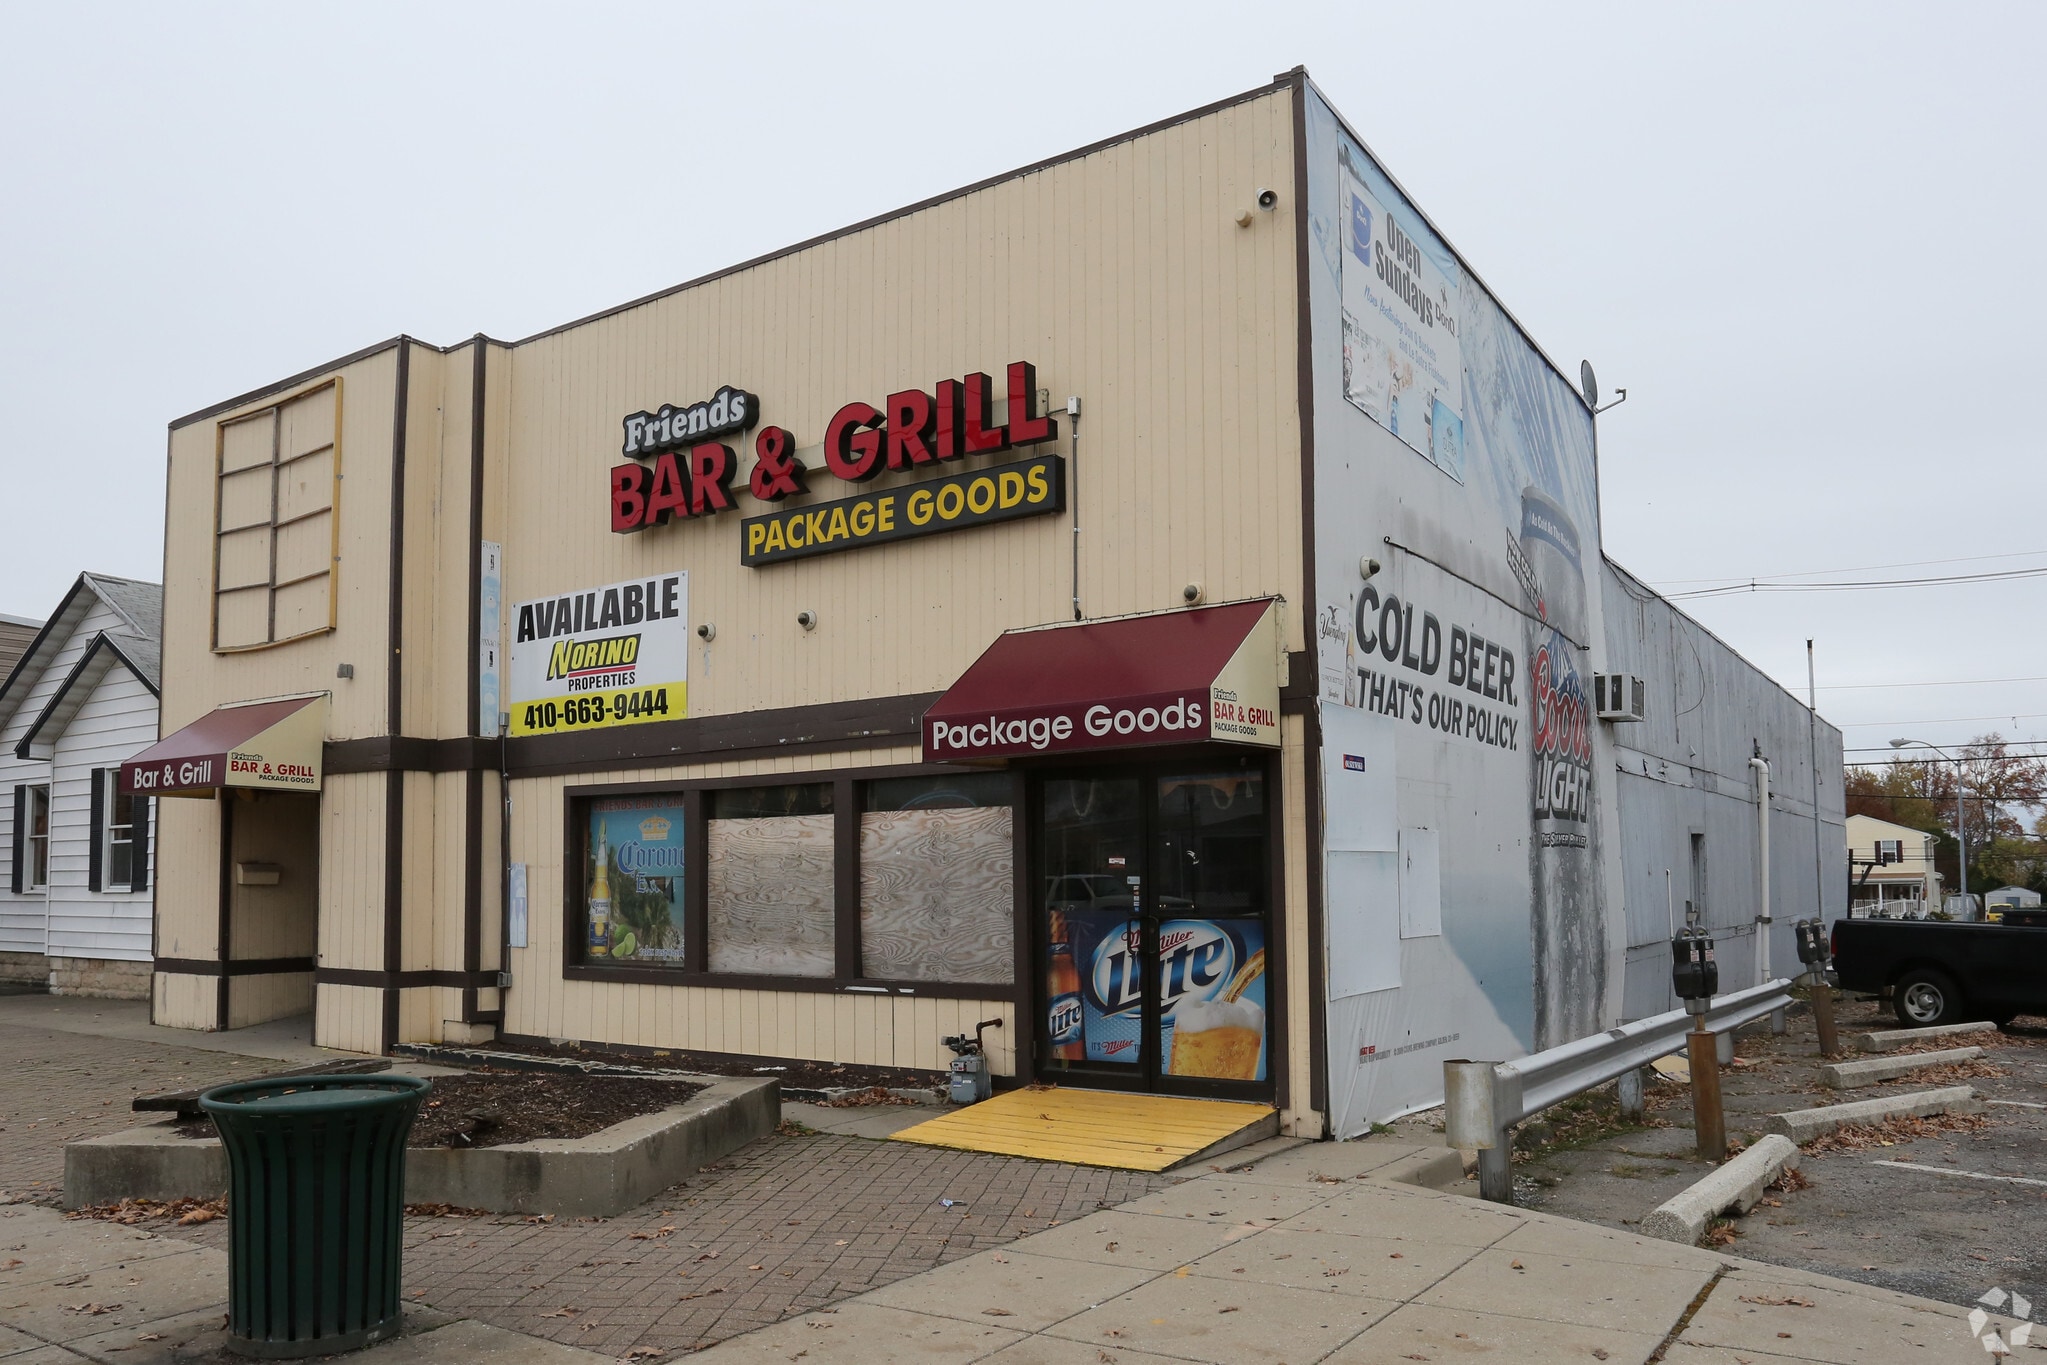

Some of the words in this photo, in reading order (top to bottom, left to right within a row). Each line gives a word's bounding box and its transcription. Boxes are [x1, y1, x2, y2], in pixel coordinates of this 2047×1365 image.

[1387, 212, 1421, 279] Open
[1375, 240, 1433, 328] Sundays
[1435, 302, 1456, 337] DonQ
[625, 389, 746, 453] Friends
[611, 442, 738, 534] BAR
[749, 425, 809, 502] &
[824, 360, 1058, 483] GRILL
[748, 496, 896, 557] PACKAGE
[907, 464, 1049, 527] GOODS
[517, 578, 680, 644] AVAILABLE
[1319, 612, 1347, 647] Yuengling
[1356, 583, 1441, 676] COLD
[1448, 623, 1518, 707] BEER.
[547, 635, 640, 680] NORINO
[567, 671, 635, 692] PROPERTIES
[1214, 687, 1238, 702] Friends
[524, 689, 669, 730] 410-663-9444
[1214, 701, 1235, 721] BAR
[1238, 705, 1246, 723] &
[1248, 707, 1275, 727] GRILL
[1357, 666, 1424, 726] THAT'S
[1428, 691, 1462, 734] OUR
[1466, 707, 1518, 751] POLICY.
[1530, 644, 1592, 766] Coors
[933, 715, 1073, 750] Package
[1084, 697, 1203, 737] Goods
[1214, 722, 1237, 733] PACKAGE
[1238, 725, 1257, 736] GOODS
[231, 752, 263, 761] Friends
[231, 760, 258, 773] BAR
[262, 763, 272, 774] &
[277, 764, 314, 777] GRILL
[133, 767, 158, 789] Bar
[163, 764, 175, 787] &
[179, 760, 212, 786] Grill
[259, 774, 288, 782] PACKAGE
[290, 776, 314, 784] GOODS
[1535, 751, 1591, 822] LIGHT
[594, 799, 633, 812] FRIENDS
[635, 798, 654, 810] BAR
[1050, 1005, 1082, 1038] Lite
[1055, 1002, 1073, 1014] Miller
[1101, 1039, 1134, 1055] Miller
